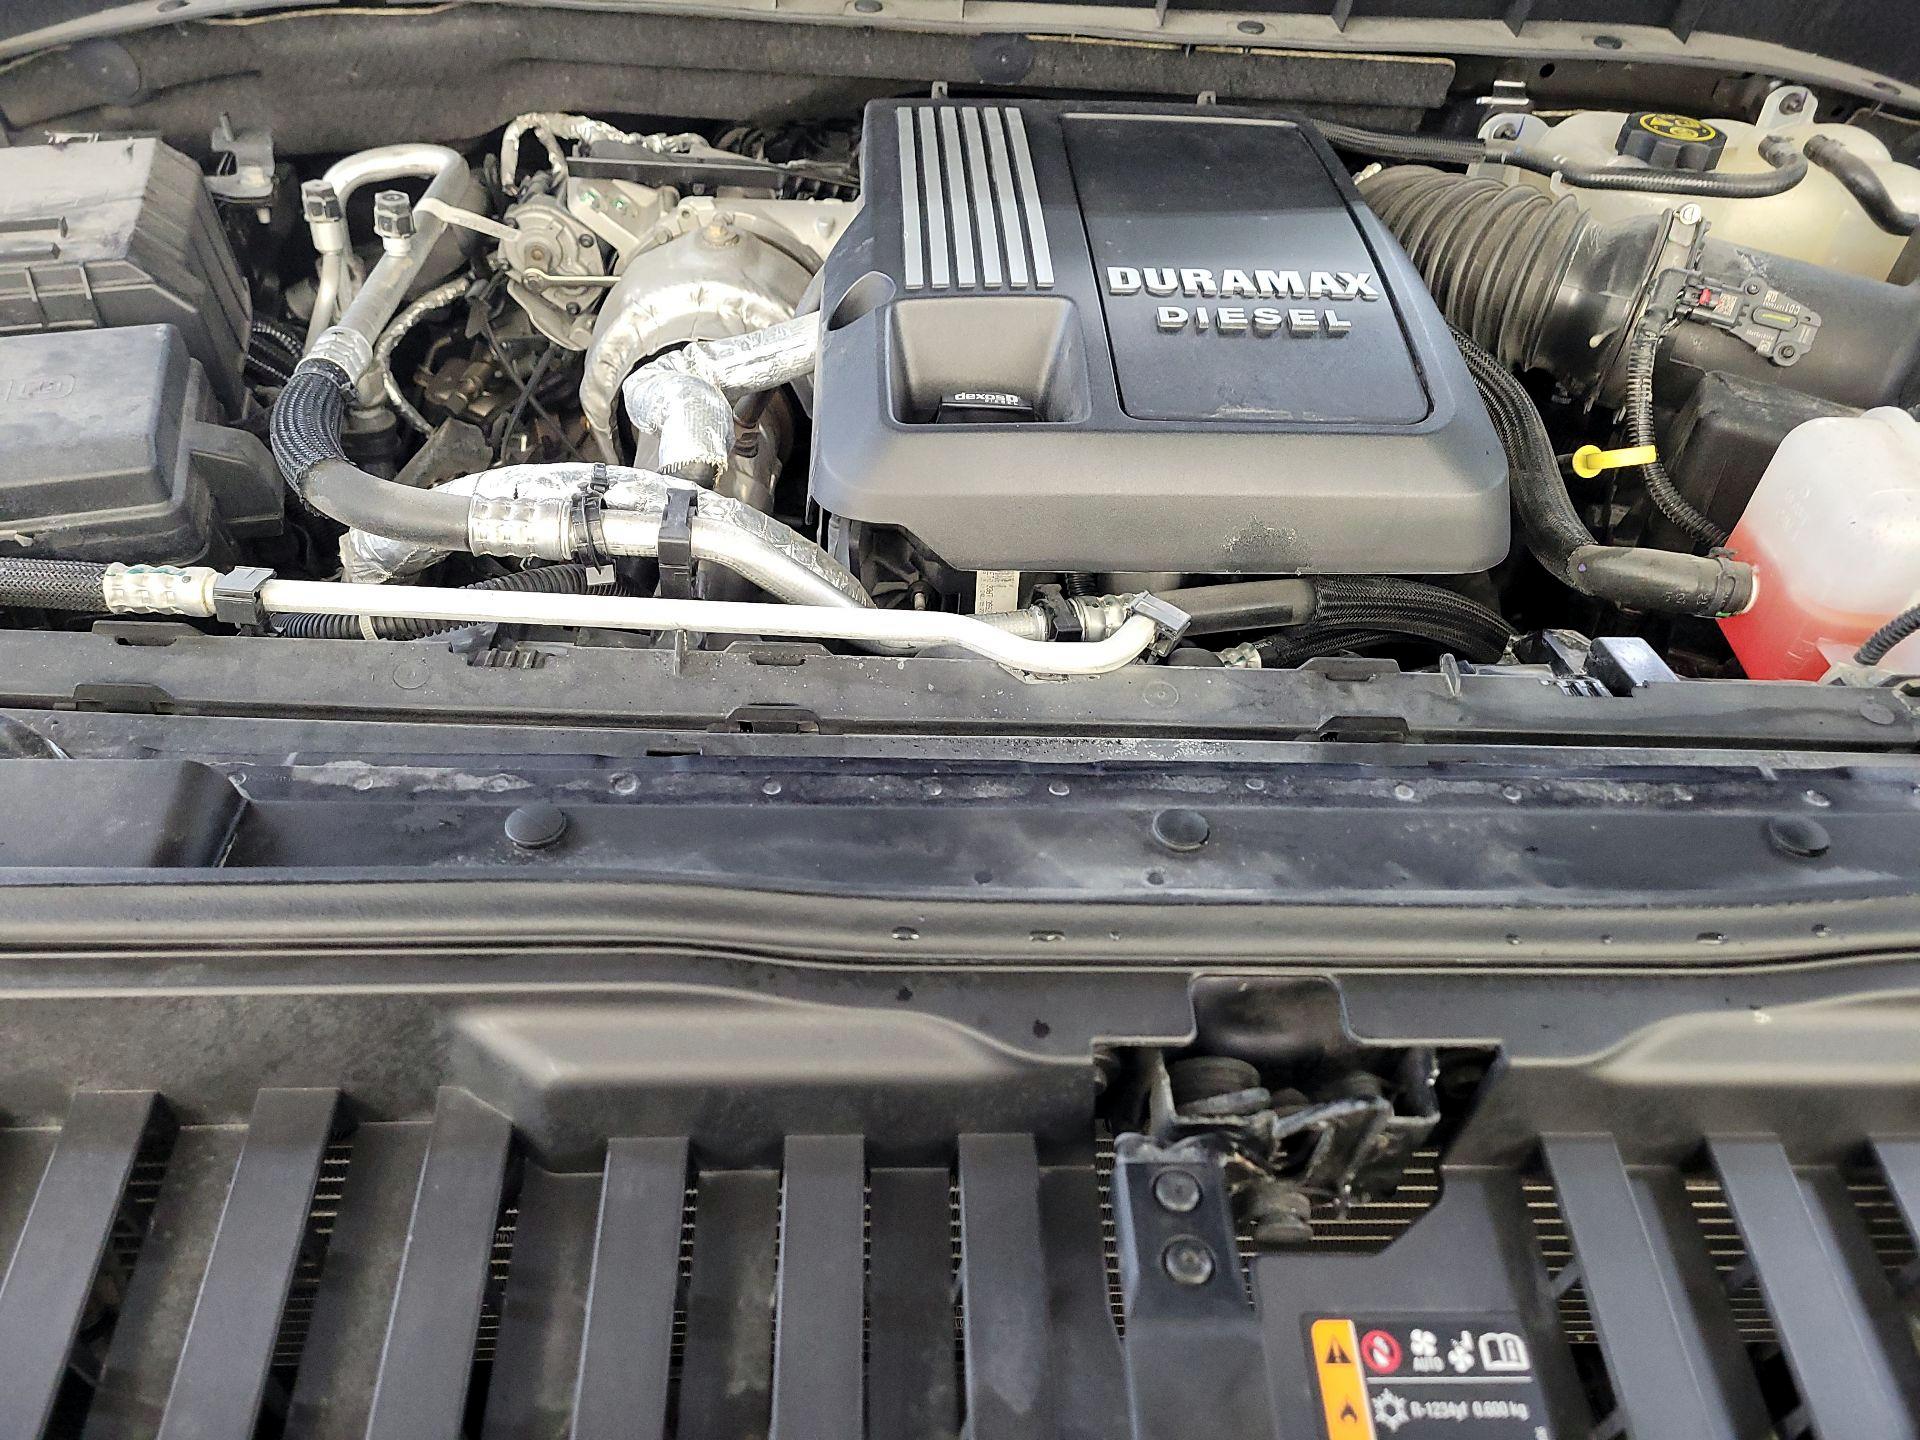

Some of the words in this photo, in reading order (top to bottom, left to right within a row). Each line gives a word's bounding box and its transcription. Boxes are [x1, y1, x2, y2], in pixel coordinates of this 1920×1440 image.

[1107, 266, 1379, 300] DURAMAX
[1155, 306, 1352, 332] DIESEL
[1413, 1356, 1445, 1372] AUTO
[1410, 1400, 1467, 1421] R-1234yf
[1509, 1401, 1528, 1420] kg
